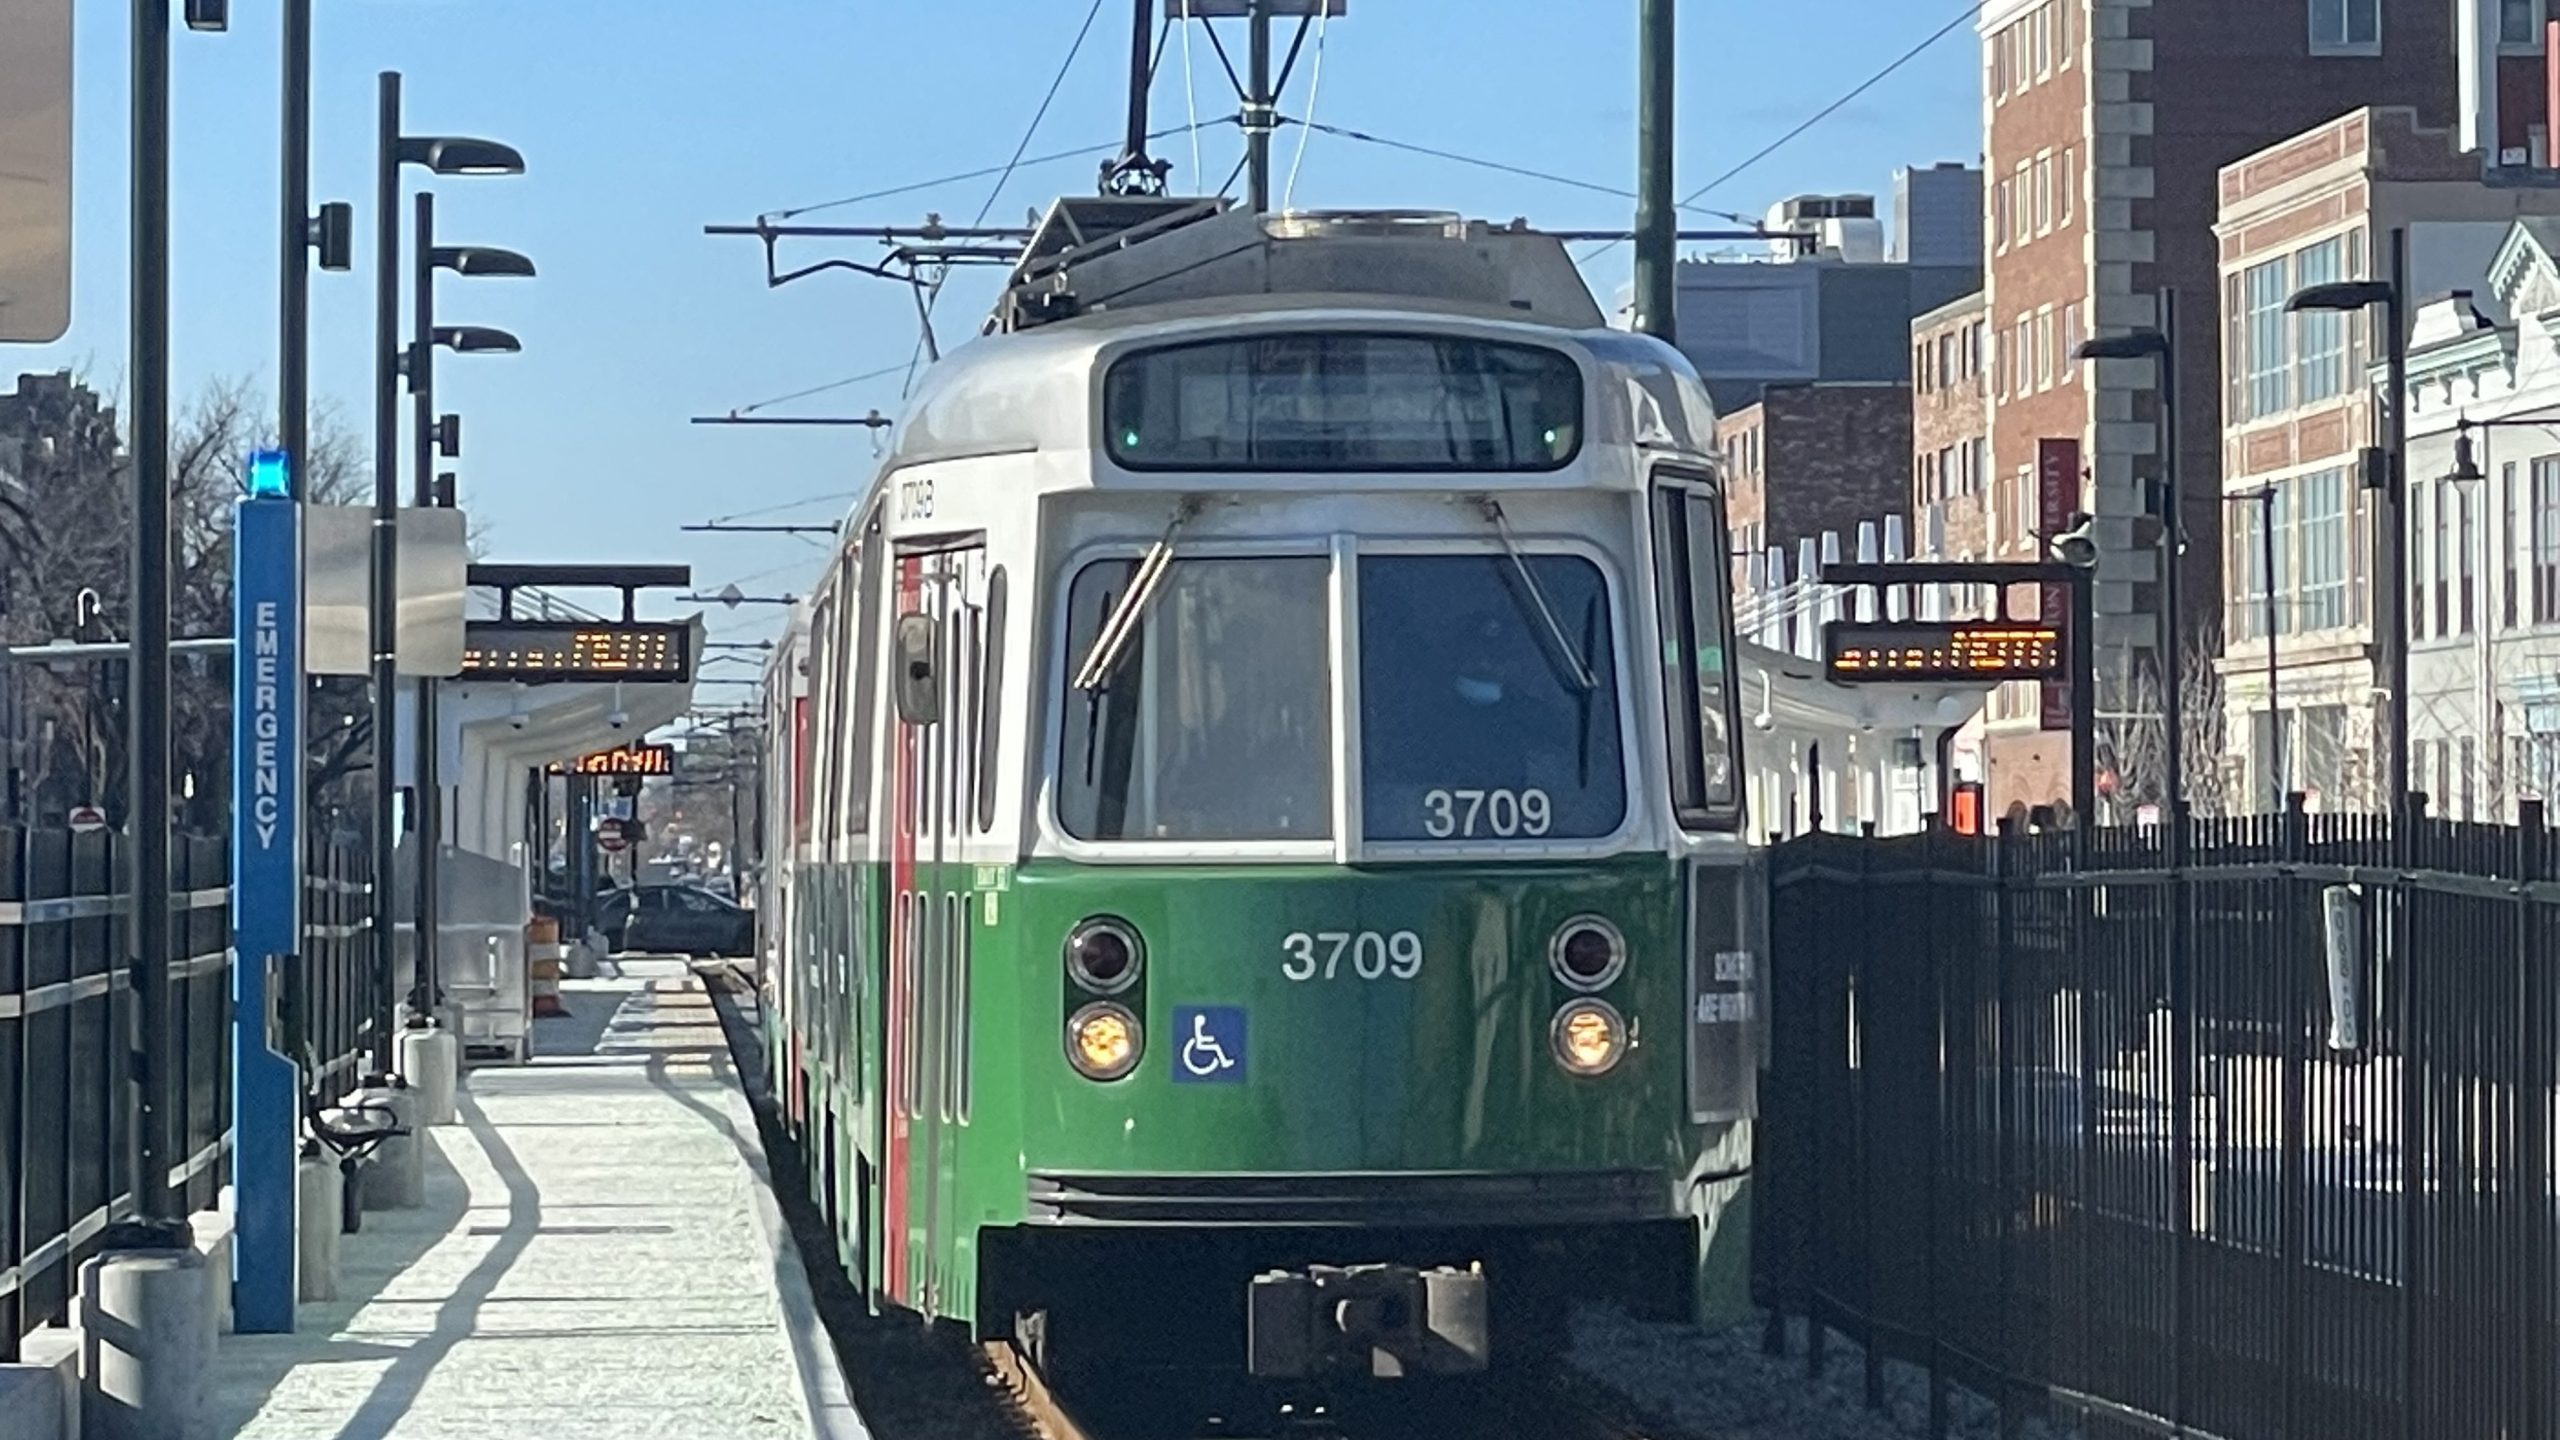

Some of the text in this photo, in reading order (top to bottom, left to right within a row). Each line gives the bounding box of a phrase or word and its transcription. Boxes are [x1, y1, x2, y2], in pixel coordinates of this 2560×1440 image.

[255, 602, 278, 849] EMERGENCY
[1424, 789, 1550, 838] 3709
[1282, 931, 1423, 980] 3709
